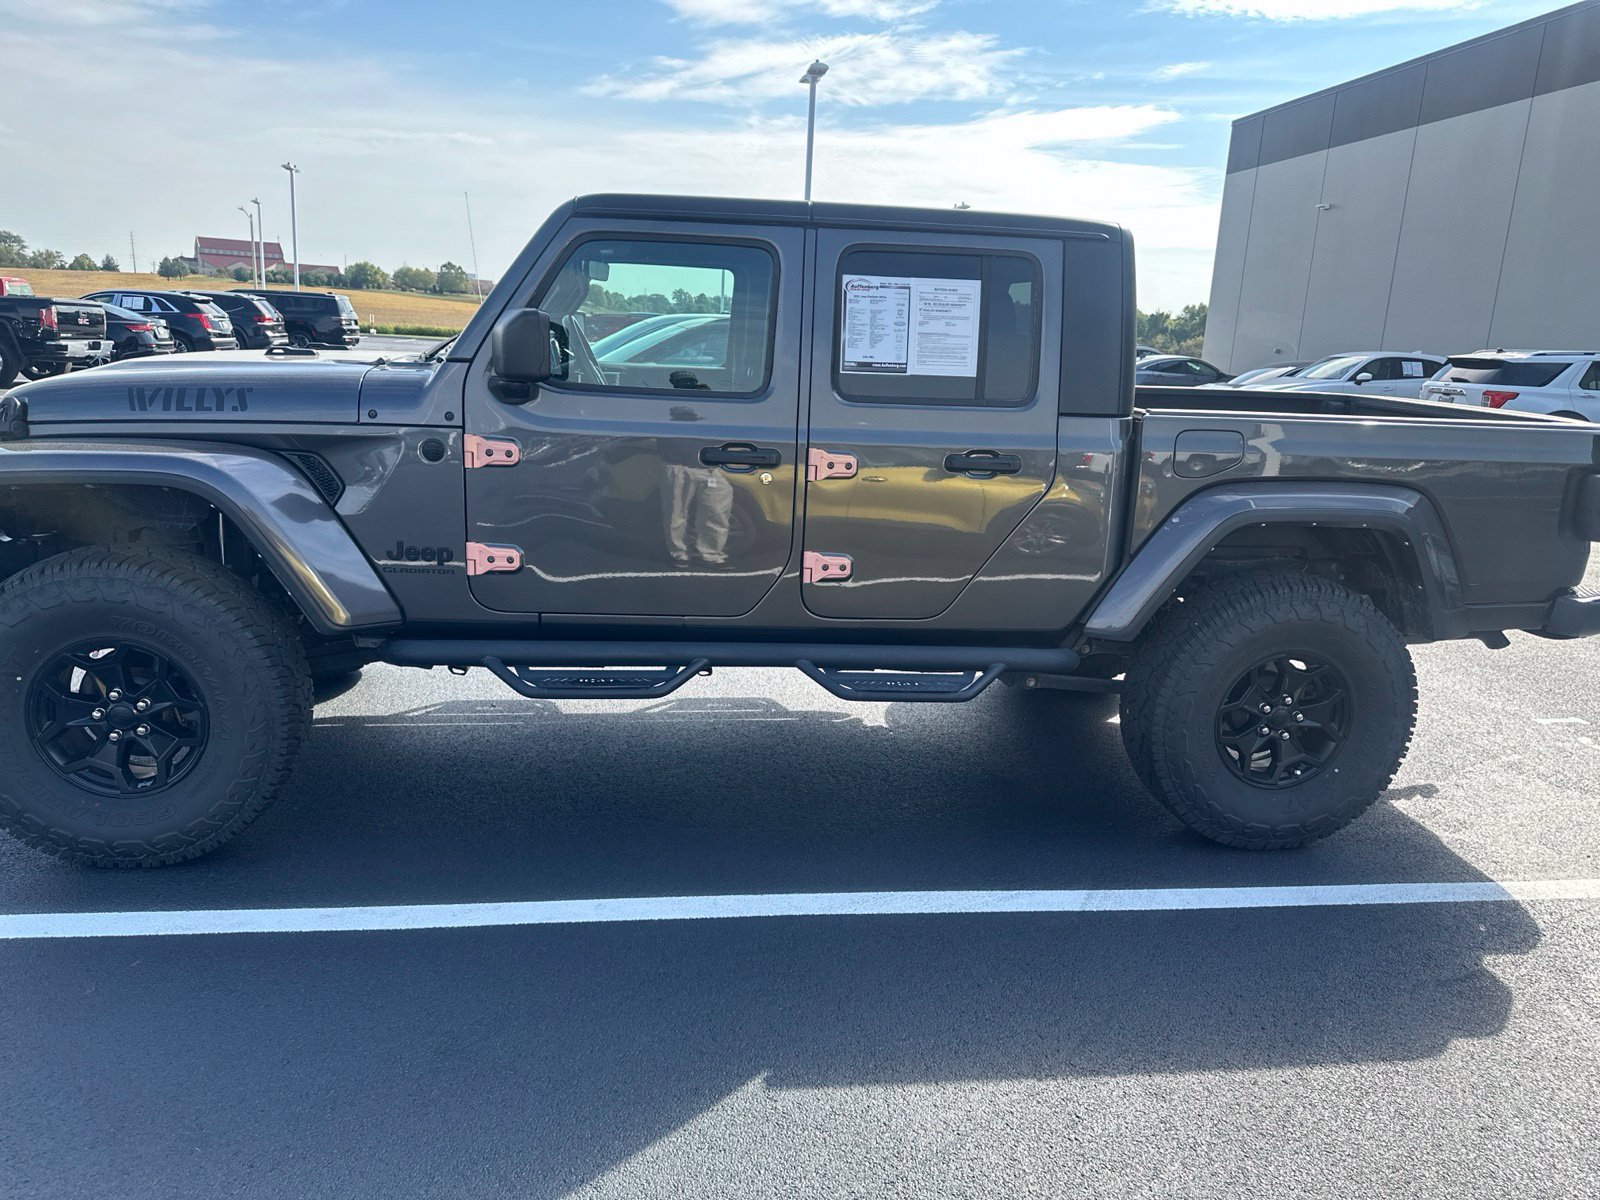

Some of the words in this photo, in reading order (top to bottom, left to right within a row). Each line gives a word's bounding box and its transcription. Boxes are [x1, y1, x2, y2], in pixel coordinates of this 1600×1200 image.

[128, 387, 254, 412] WILLYS
[386, 540, 454, 567] Jeep
[382, 566, 456, 575] GLADIATOR
